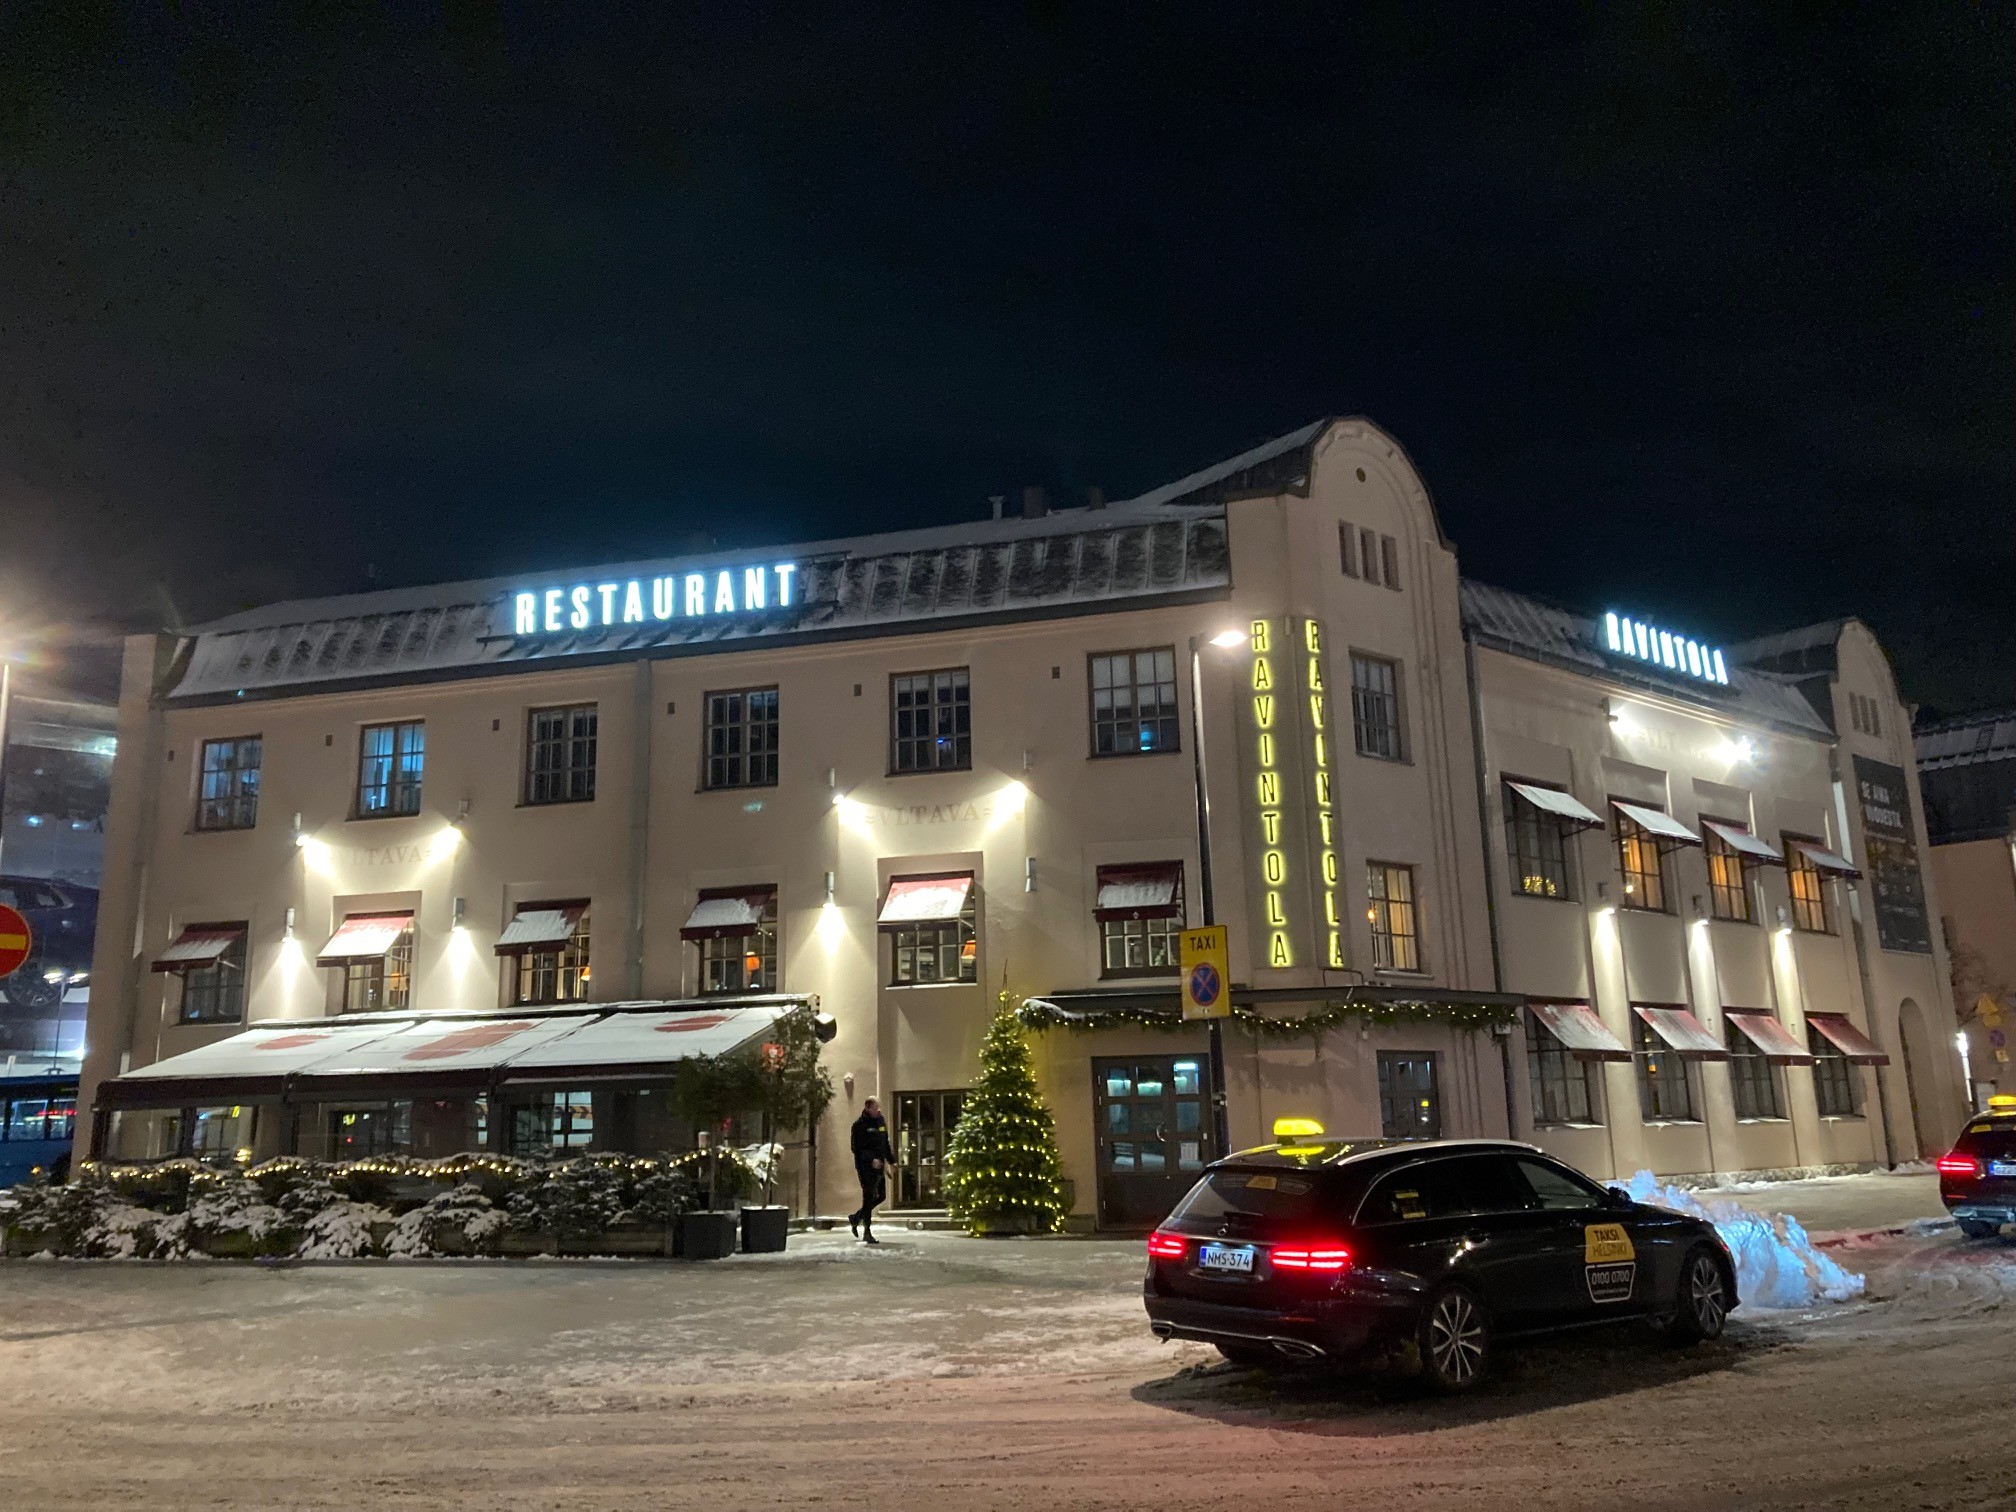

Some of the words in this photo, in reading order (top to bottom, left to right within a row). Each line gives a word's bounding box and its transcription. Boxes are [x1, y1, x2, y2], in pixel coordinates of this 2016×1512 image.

[515, 563, 796, 635] RESTAURANT
[1605, 612, 1729, 685] RAVINTOLA
[1252, 620, 1291, 966] RAVINTOLA
[1305, 619, 1345, 967] RAVINTOLA
[878, 803, 980, 826] VLTAVA
[338, 846, 424, 867] LTAVA
[1190, 934, 1216, 952] TAXI
[1593, 1229, 1620, 1241] TAKSI
[1207, 1252, 1250, 1268] NMS-374
[1611, 1270, 1630, 1283] 0700
